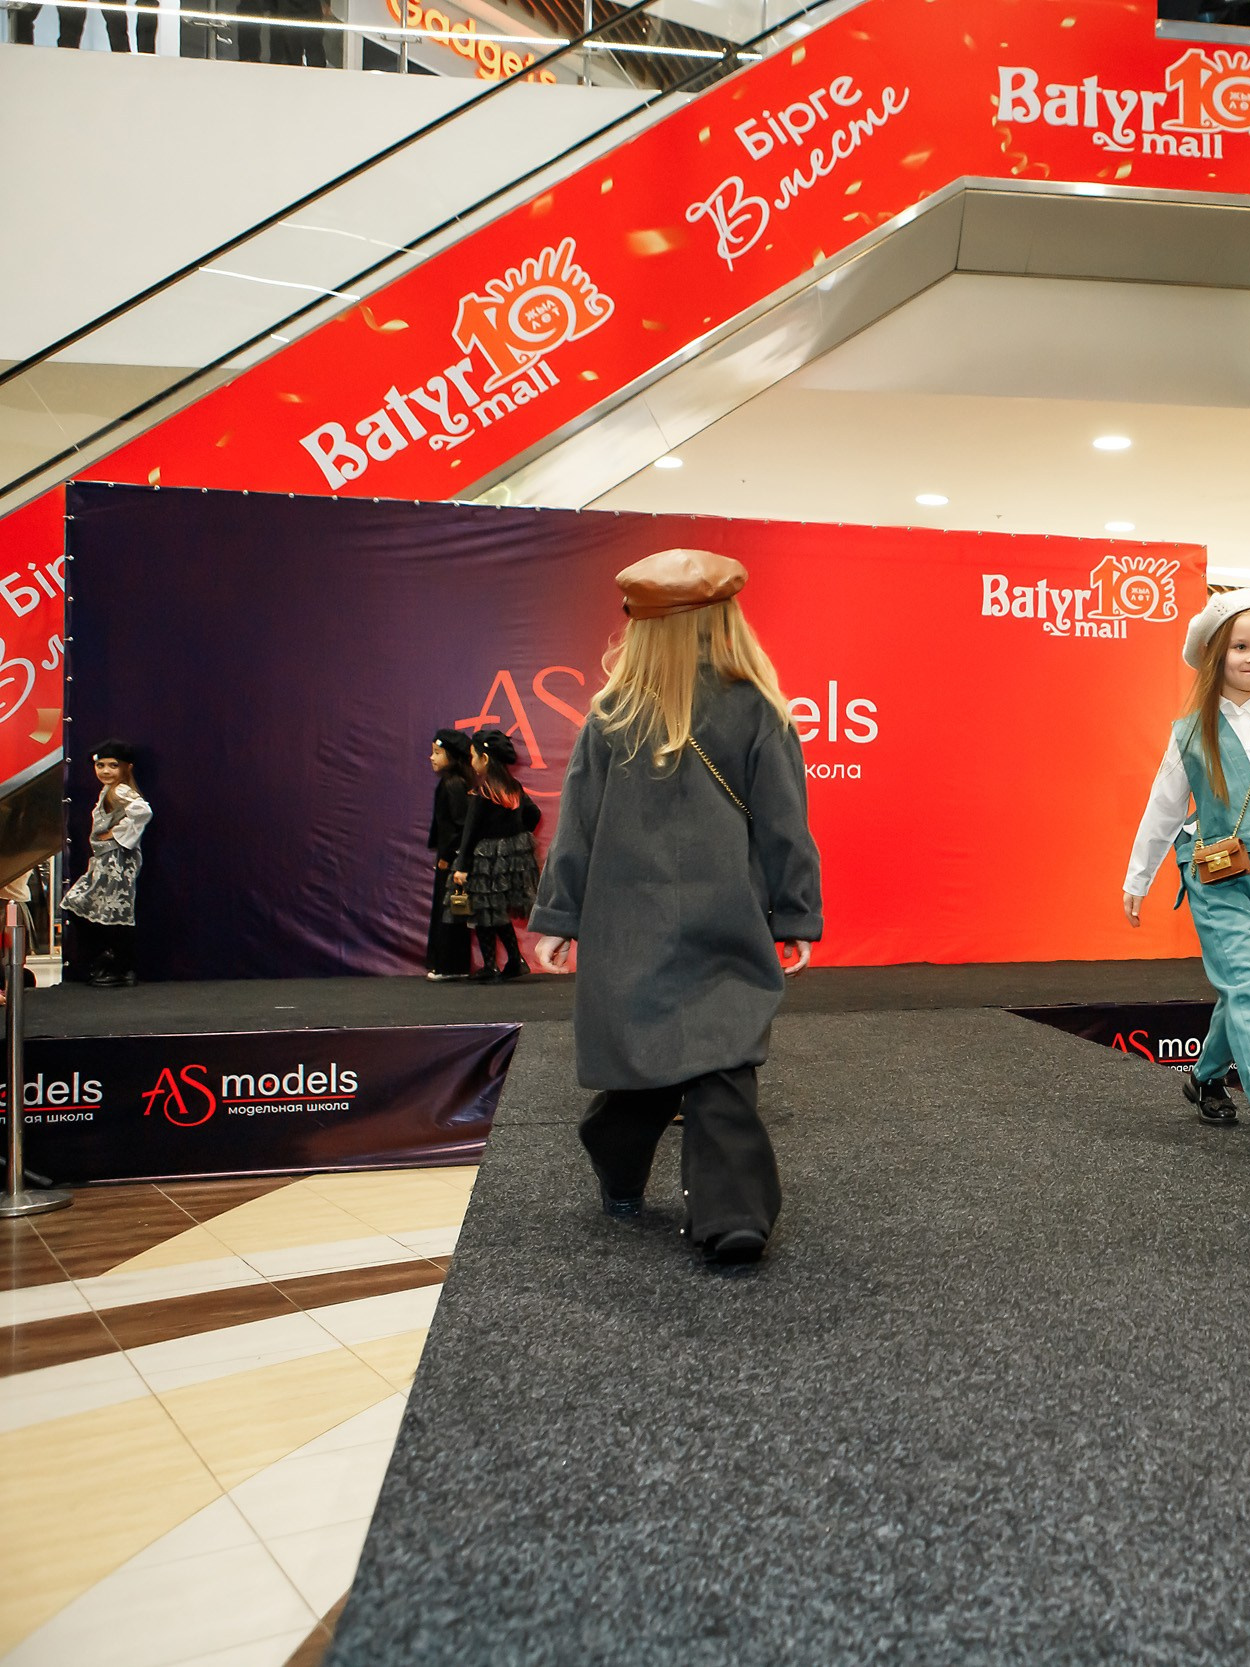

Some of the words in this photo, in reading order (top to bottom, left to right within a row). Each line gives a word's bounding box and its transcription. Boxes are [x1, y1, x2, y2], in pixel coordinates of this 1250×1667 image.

[734, 75, 863, 161] Бірге
[998, 66, 1166, 151] Batyr
[1142, 132, 1223, 159] mall
[685, 86, 910, 272] Вместе
[299, 357, 481, 491] Batyr
[472, 359, 560, 428] mall
[981, 574, 1092, 637] Batyr
[1074, 619, 1127, 639] mall
[804, 763, 862, 779] кола
[46, 1112, 94, 1123] школа
[141, 1064, 217, 1127] AS
[222, 1062, 358, 1098] models
[228, 1103, 303, 1116] модельная
[306, 1101, 350, 1112] школа
